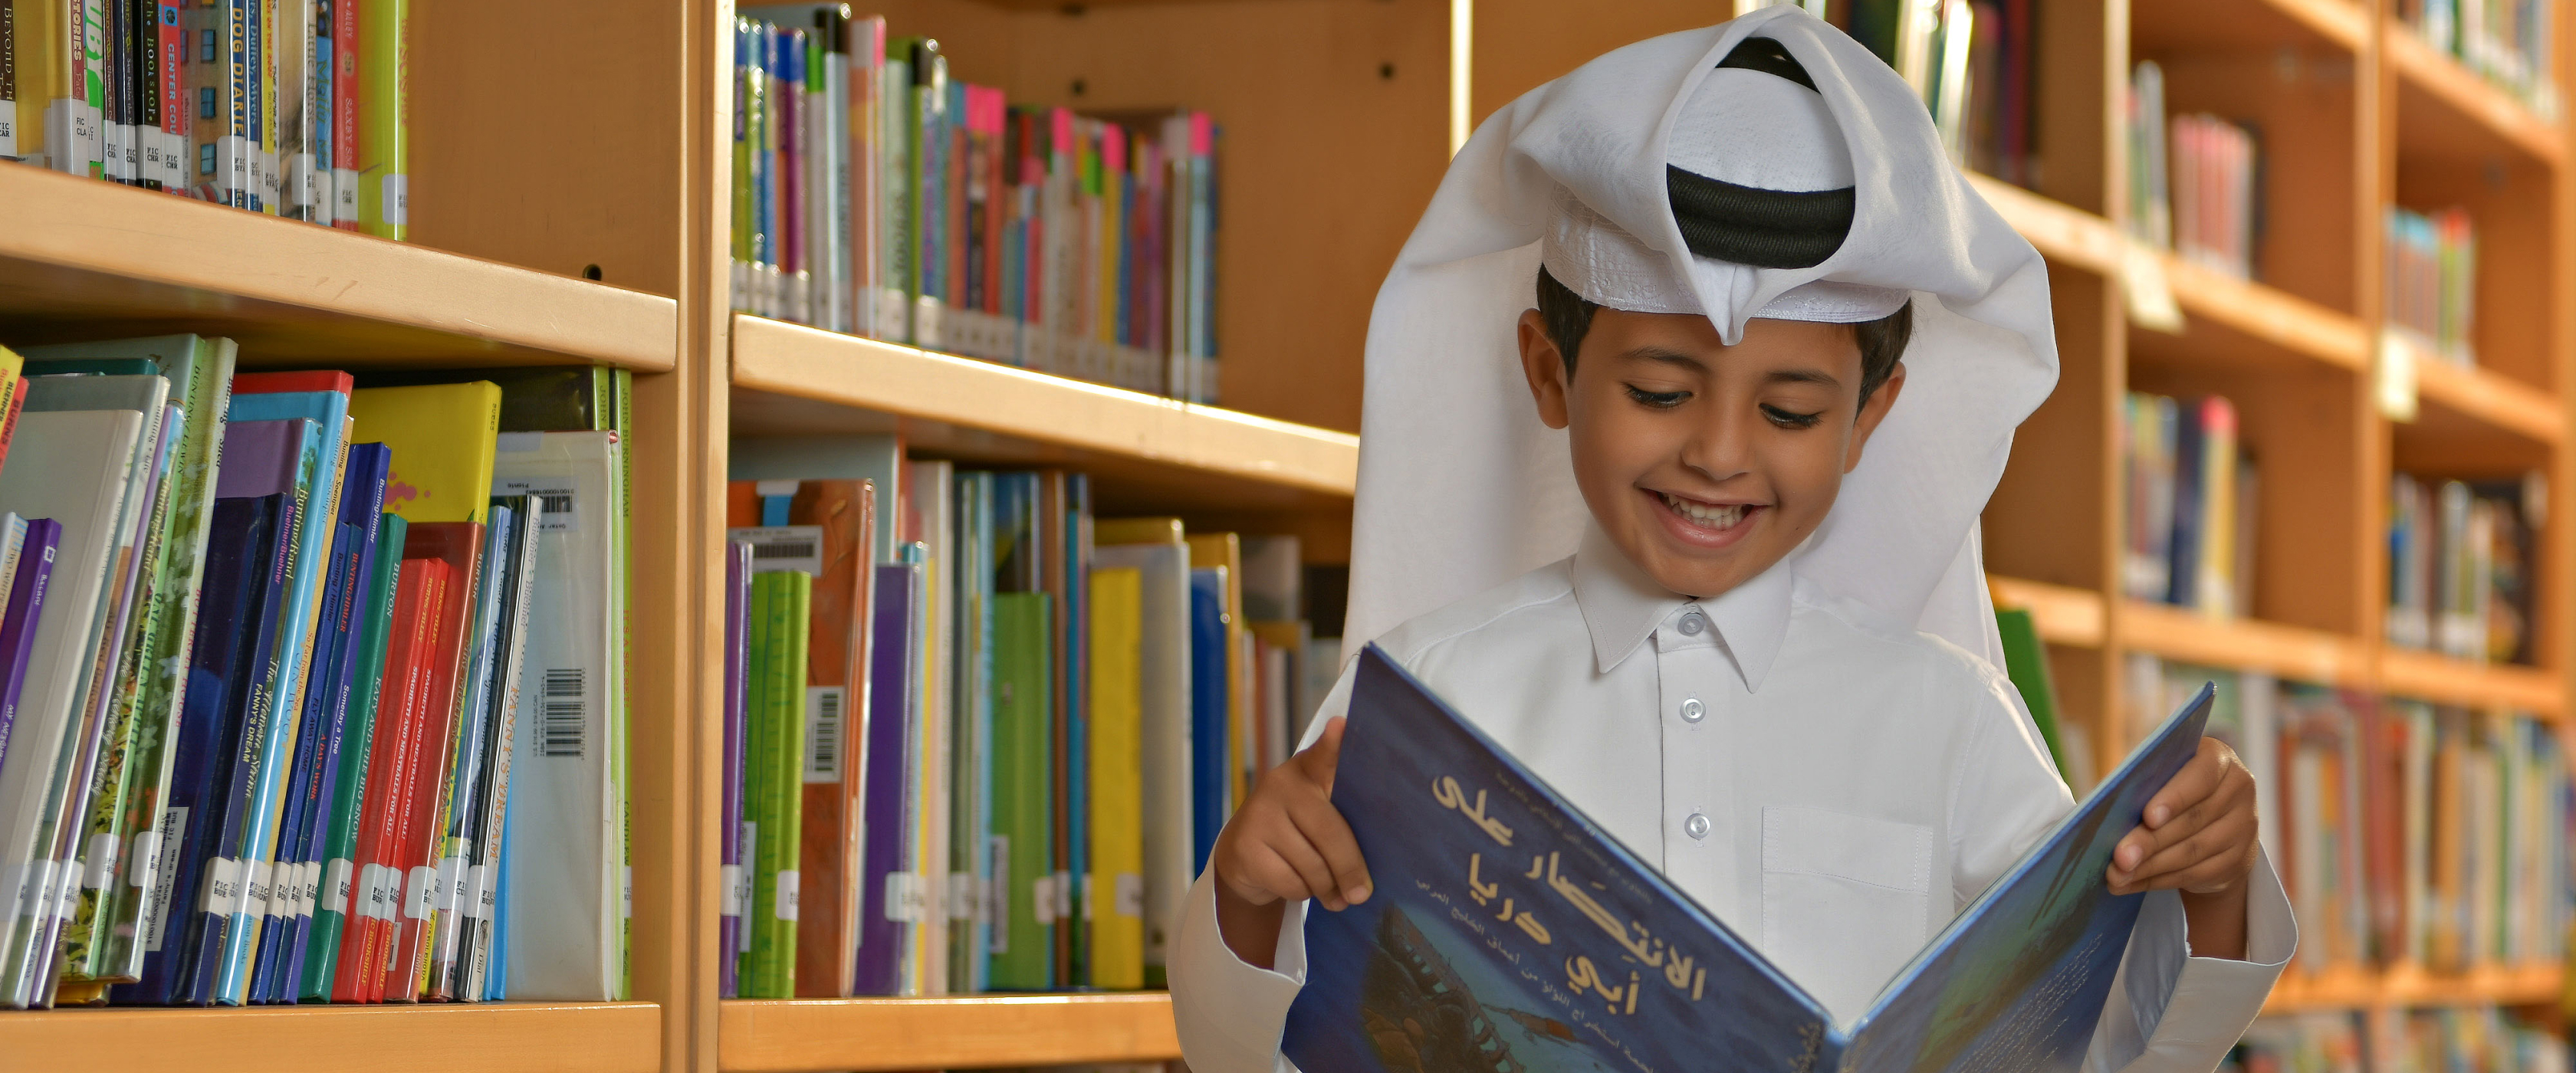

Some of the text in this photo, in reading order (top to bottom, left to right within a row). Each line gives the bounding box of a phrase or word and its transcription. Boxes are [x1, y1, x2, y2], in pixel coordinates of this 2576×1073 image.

[4, 8, 12, 74] BEYOND
[232, 8, 245, 134] DOG DIARIE
[169, 104, 177, 134] COU
[337, 440, 348, 468] Bunting
[368, 477, 385, 543] Bunting/Himler
[472, 553, 481, 599] BURTON
[306, 631, 313, 642] So
[298, 658, 307, 678] from
[248, 683, 262, 724] FANNY'S
[336, 684, 350, 725] Someday
[350, 562, 399, 842] BURTON KATY AND THE BIG SNOW
[404, 665, 418, 717] SPAGHETTI
[419, 668, 432, 719] SPAGHETTI
[310, 697, 319, 714] FLY
[306, 716, 315, 743] AWAY
[401, 717, 409, 738] AND
[415, 720, 423, 741] AND
[242, 727, 255, 763] DREAM
[332, 735, 340, 754] Tree
[301, 745, 310, 773] HOME
[392, 739, 406, 793] MEATBALLS
[406, 742, 420, 796] MEATBALLS
[309, 771, 320, 800] WORK
[388, 795, 396, 813] FOR
[1432, 776, 1513, 847] على
[385, 815, 393, 836] ALL!
[214, 888, 227, 897] BUE
[215, 880, 228, 891] FIC
[372, 894, 383, 904] BUR
[373, 887, 383, 897] FIC
[1415, 879, 1450, 906] العربي
[1469, 853, 1641, 1016] أبي دريا
[360, 930, 374, 986] BOOKSHELF
[1520, 967, 1539, 982] من
